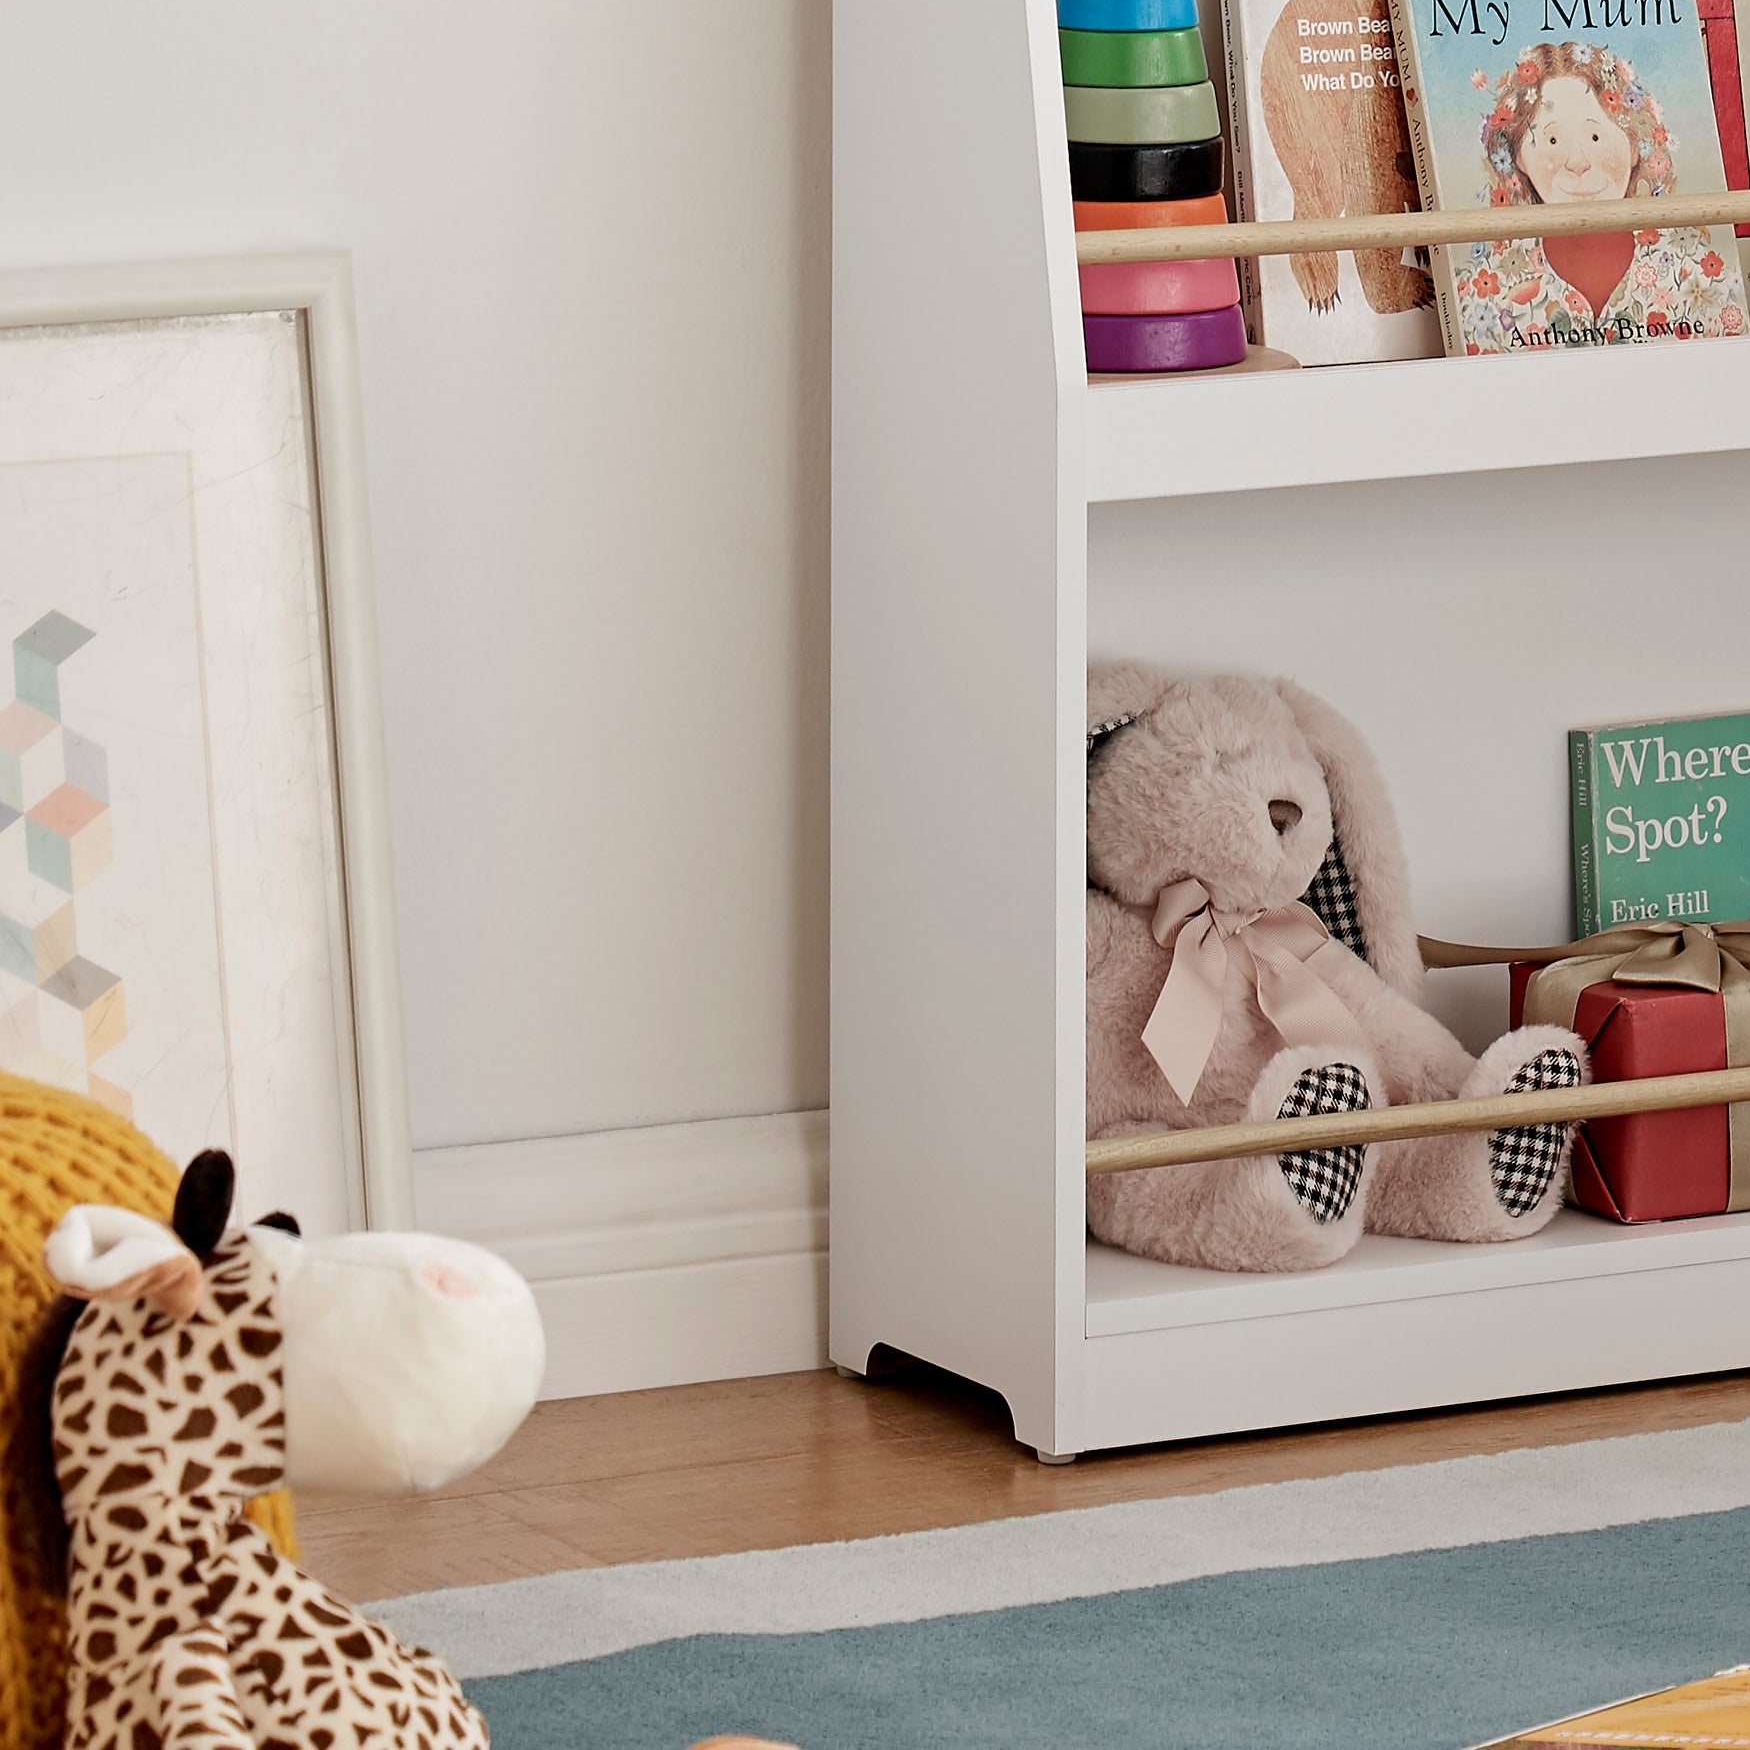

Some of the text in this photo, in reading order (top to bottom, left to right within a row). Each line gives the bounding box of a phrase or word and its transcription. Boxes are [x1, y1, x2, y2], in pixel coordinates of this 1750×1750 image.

[1297, 16, 1391, 36] Brown Bea
[1227, 50, 1235, 82] What
[1300, 46, 1355, 63] Brown
[1231, 82, 1236, 99] Do
[1301, 71, 1400, 90] What Do Yo
[1396, 30, 1411, 81] MUM
[1412, 118, 1429, 189] Anthony
[1233, 125, 1241, 153] See?
[1440, 292, 1454, 350] Doubleday
[1510, 318, 1704, 348] Anthony Browne
[1576, 743, 1592, 936] Eric Hill Where's Spo
[1605, 795, 1727, 863] Spot?
[1610, 890, 1710, 924] Eric Hill
